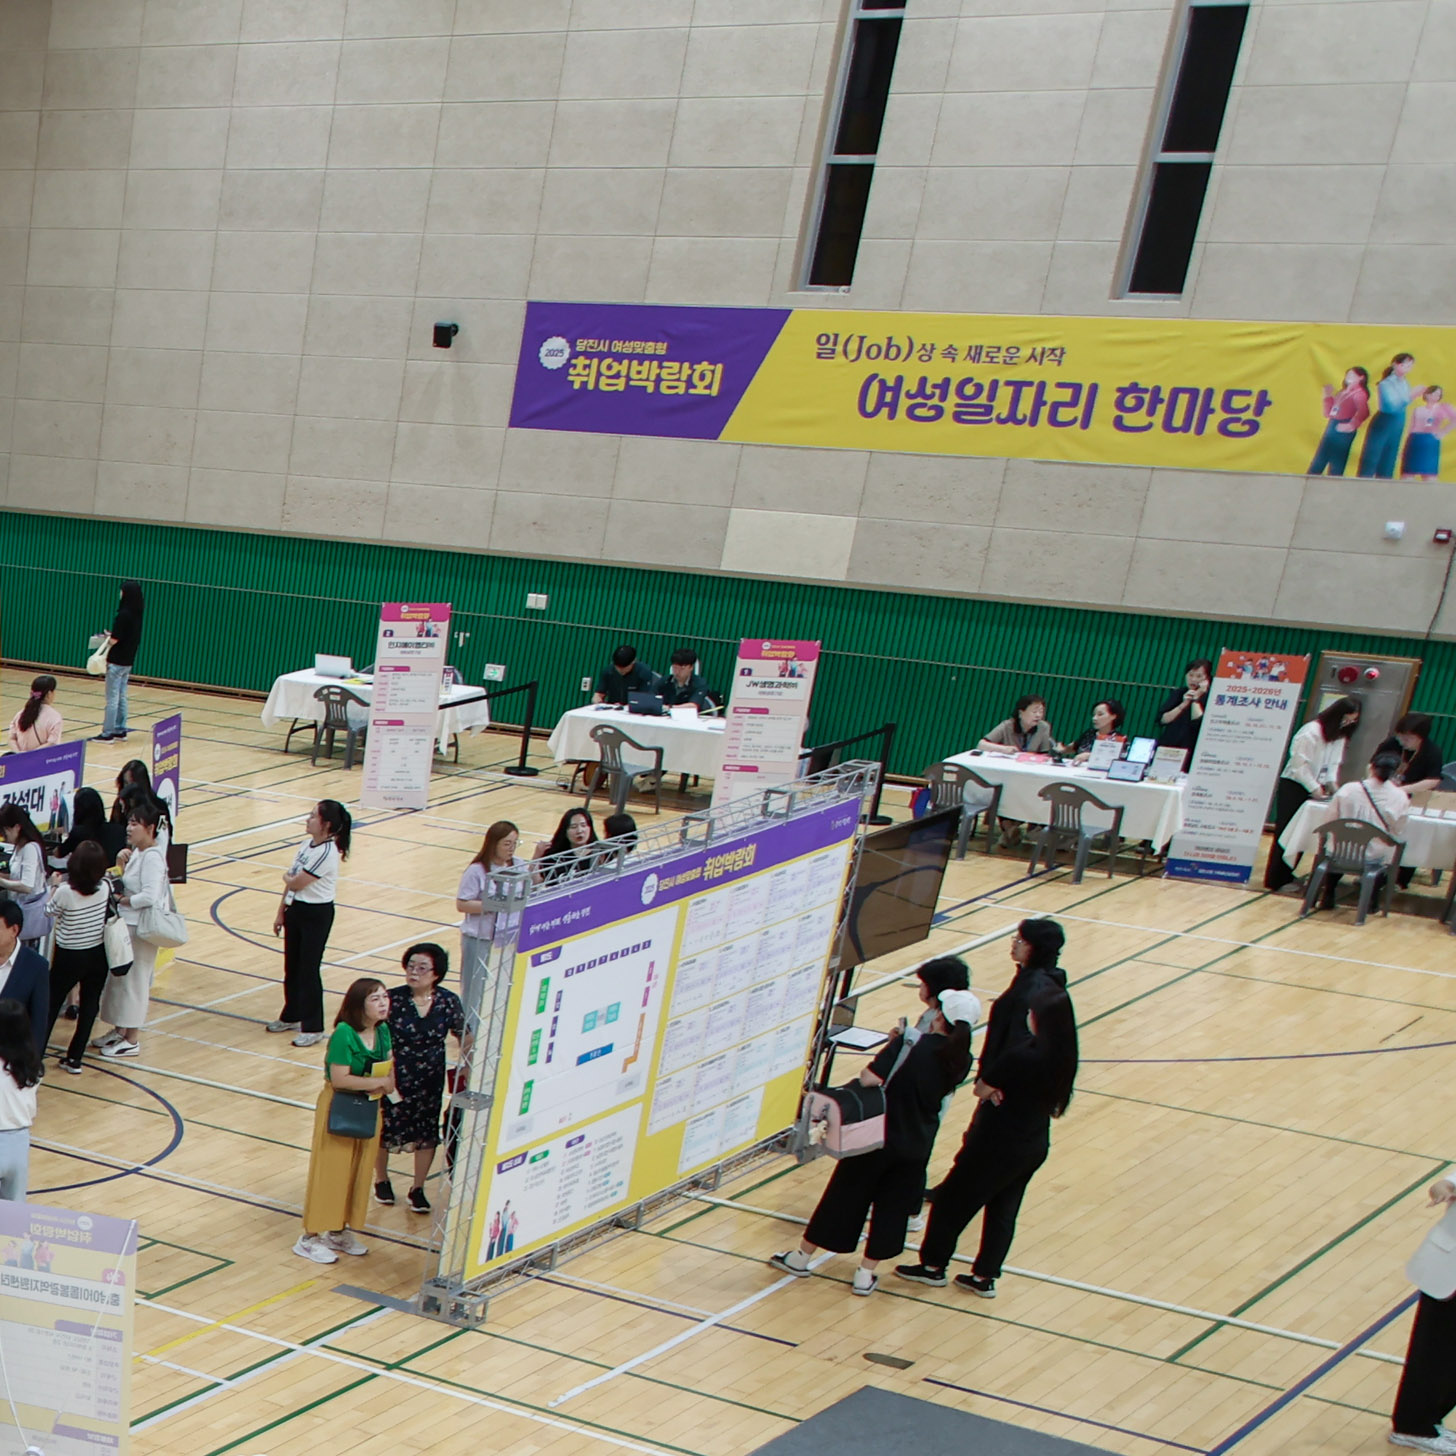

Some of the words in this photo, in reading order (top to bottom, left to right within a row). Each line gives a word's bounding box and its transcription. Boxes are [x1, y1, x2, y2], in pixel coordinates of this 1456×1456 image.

[544, 347, 565, 359] 2025
[575, 338, 609, 353] 당진시
[611, 340, 668, 356] 여성맞춤형
[940, 343, 958, 363] 속
[963, 344, 1021, 366] 새로운
[1026, 345, 1066, 367] 시작
[567, 356, 723, 397] 취업박람회
[857, 372, 1099, 431] 여성일자리
[1113, 381, 1272, 438] 한마당
[1214, 694, 1262, 707] 통계조사
[1264, 697, 1288, 711] 안내
[702, 843, 757, 881] 취업박람회
